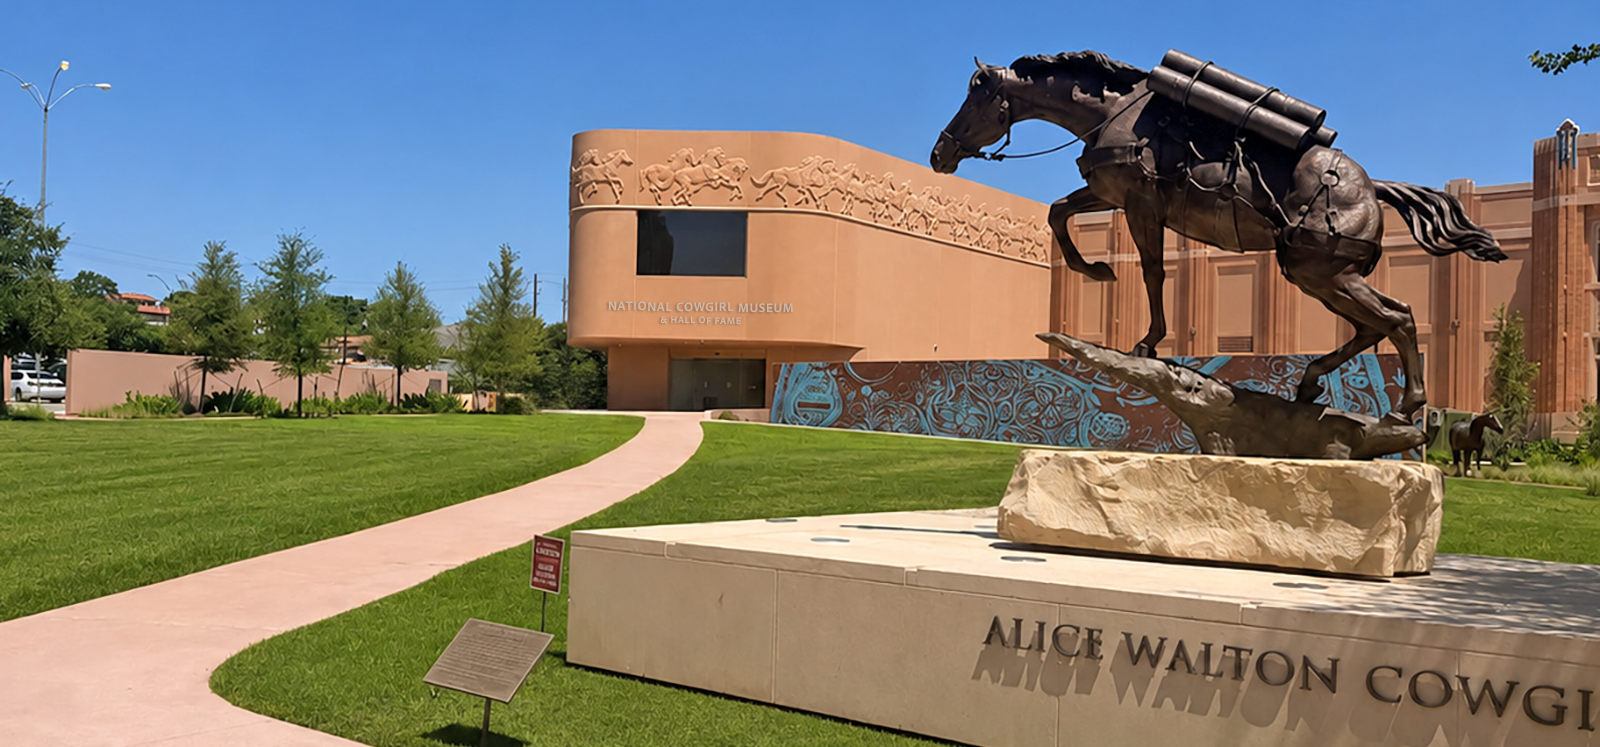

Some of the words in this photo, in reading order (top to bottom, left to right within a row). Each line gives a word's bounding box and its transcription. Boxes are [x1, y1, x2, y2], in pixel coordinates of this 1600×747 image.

[608, 301, 672, 312] NATIONAL
[676, 302, 734, 312] COWGIRL
[738, 303, 794, 313] MUSEUM
[660, 316, 668, 325] &
[670, 316, 696, 325] HALL
[698, 316, 712, 325] OF
[714, 316, 742, 326] FAME
[982, 615, 1104, 661] ALICE
[1120, 631, 1342, 695] WALTON
[1365, 664, 1595, 732] COWGI
